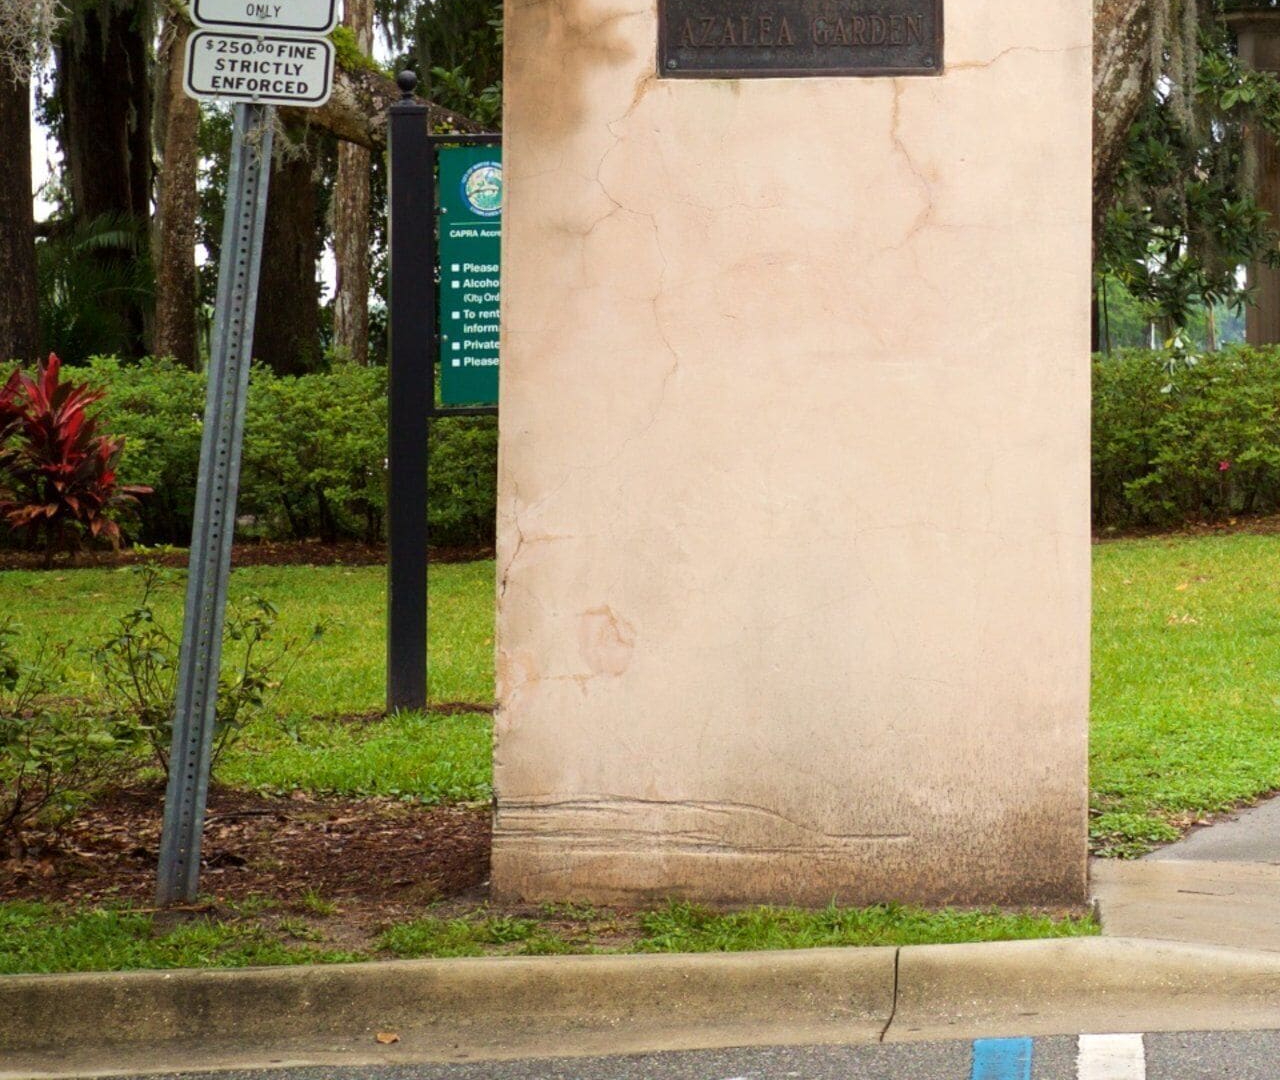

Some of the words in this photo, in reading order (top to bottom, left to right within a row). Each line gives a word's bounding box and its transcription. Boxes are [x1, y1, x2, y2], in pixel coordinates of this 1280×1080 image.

[246, 3, 281, 19] ONLY
[678, 16, 794, 47] AZALEA
[812, 14, 925, 46] GARDEN
[277, 45, 317, 60] FINE
[215, 58, 303, 76] STRICTLY
[212, 75, 309, 94] ENFORCED
[449, 229, 479, 238] CAPRA
[463, 263, 499, 273] Please
[463, 278, 500, 288] Alcoho
[463, 309, 476, 319] To
[479, 309, 501, 319] rent
[463, 323, 499, 333] inform
[463, 339, 501, 350] Private
[463, 356, 501, 367] Please
